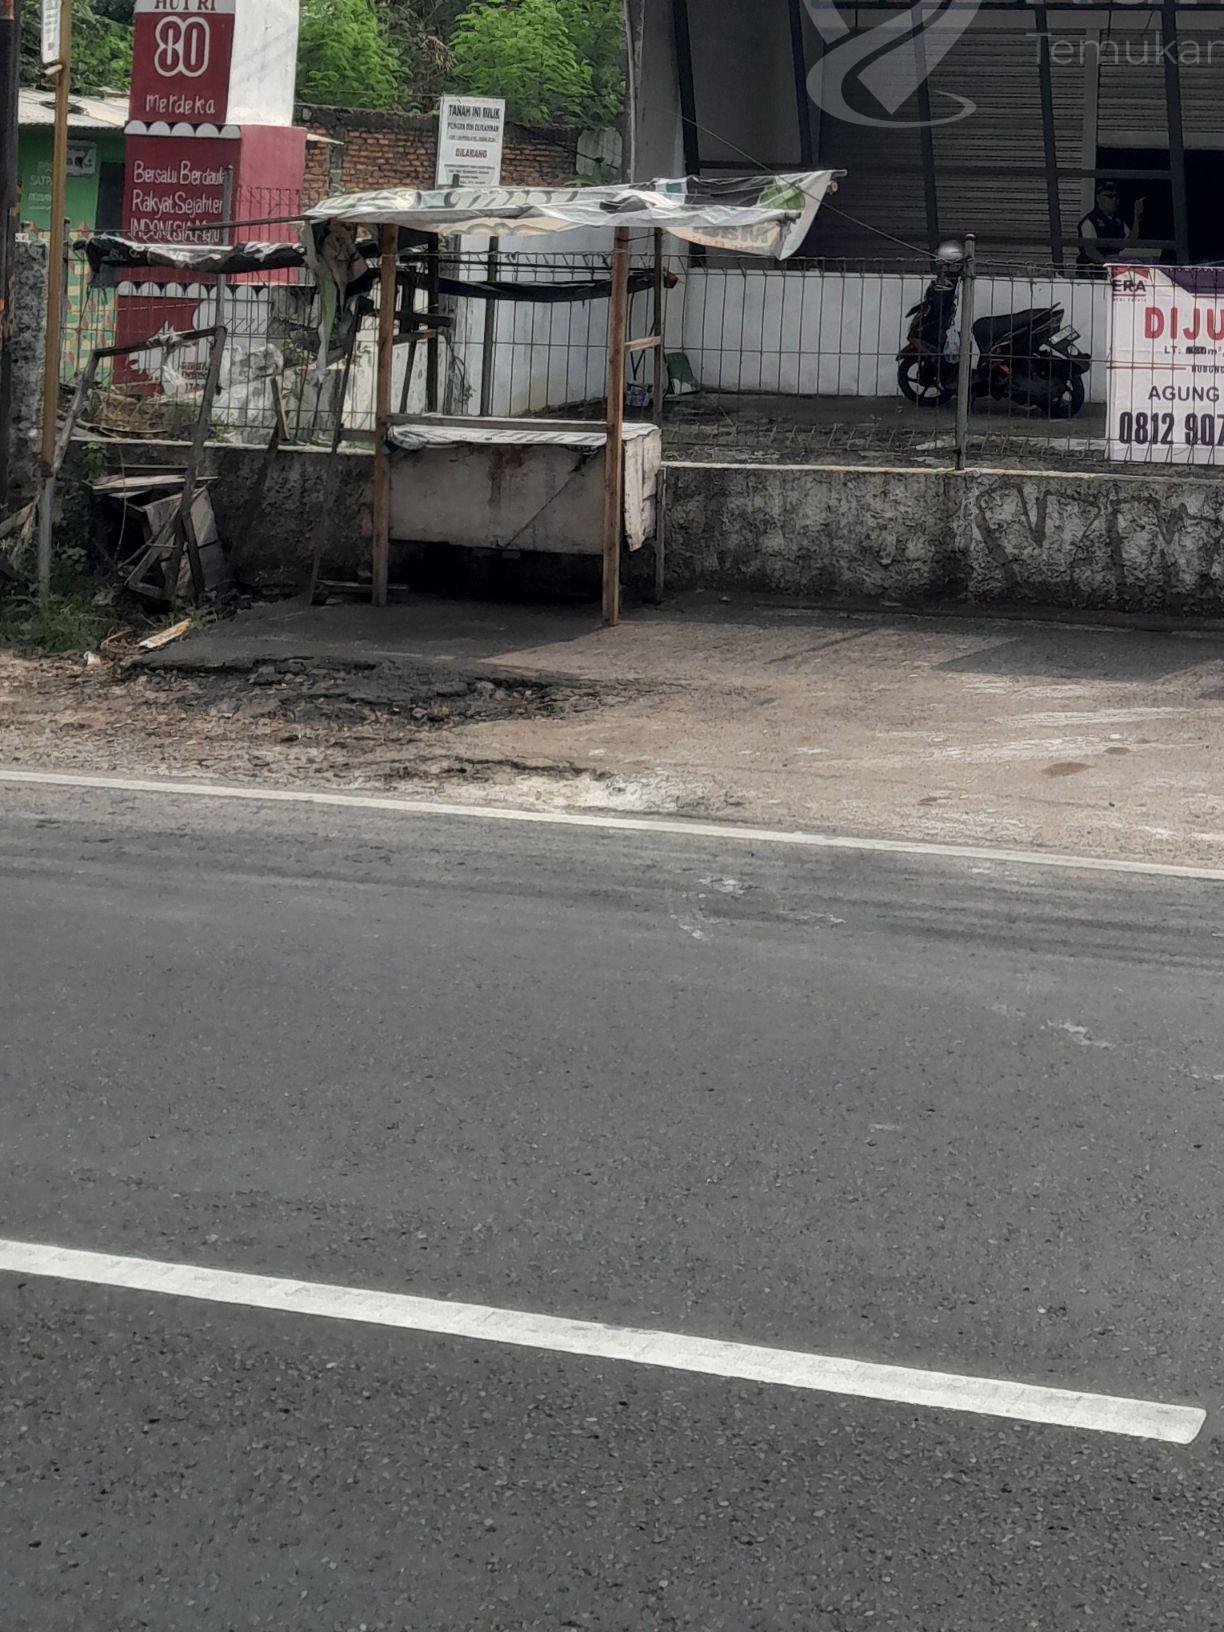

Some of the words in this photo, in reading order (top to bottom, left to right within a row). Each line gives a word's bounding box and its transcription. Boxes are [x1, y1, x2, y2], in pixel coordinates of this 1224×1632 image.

[154, 15, 210, 77] 80
[448, 104, 471, 117] TANAH
[175, 191, 223, 218] Sejahter
[1112, 279, 1147, 292] ERA
[1164, 345, 1181, 354] LT:
[1147, 385, 1220, 402] AGUNG
[1118, 411, 1175, 445] 0812
